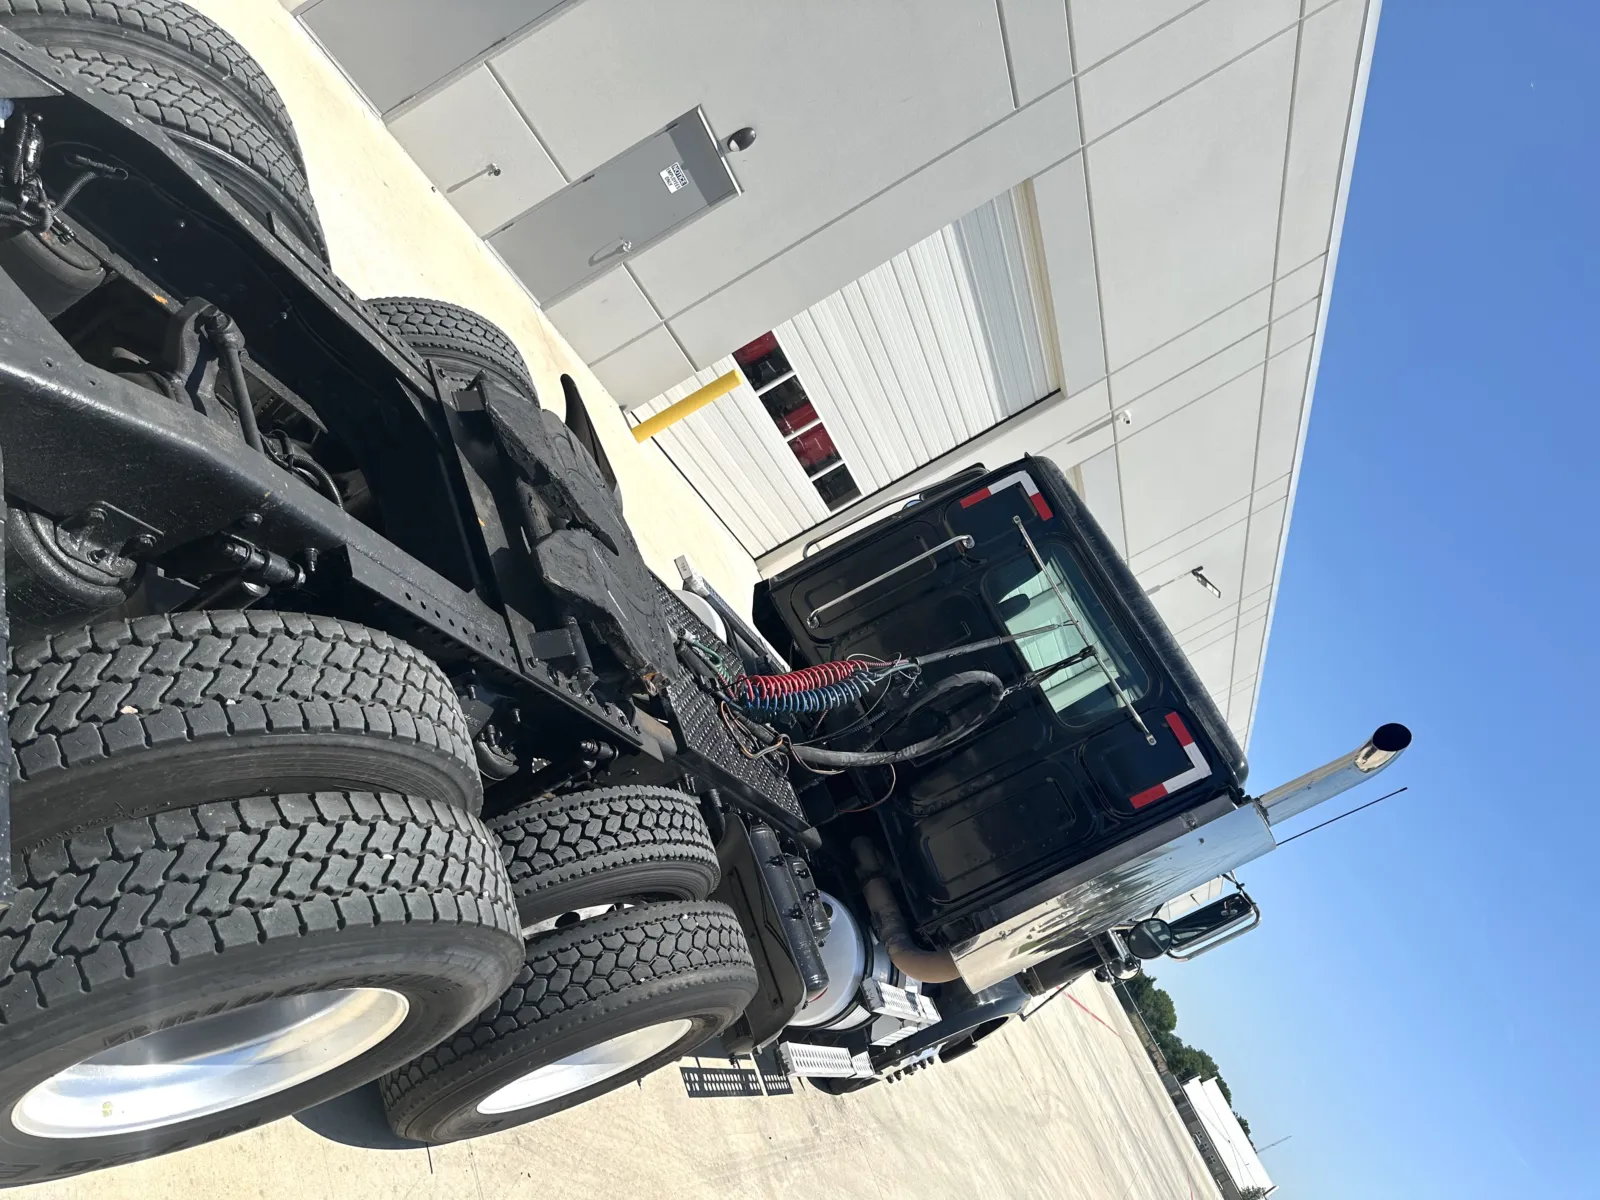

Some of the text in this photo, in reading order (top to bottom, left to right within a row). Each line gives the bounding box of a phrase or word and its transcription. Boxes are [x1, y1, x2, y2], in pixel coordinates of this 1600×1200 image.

[664, 176, 674, 187] ONLY
[666, 167, 681, 190] EMPLOYEES
[672, 163, 688, 187] NOTICE
